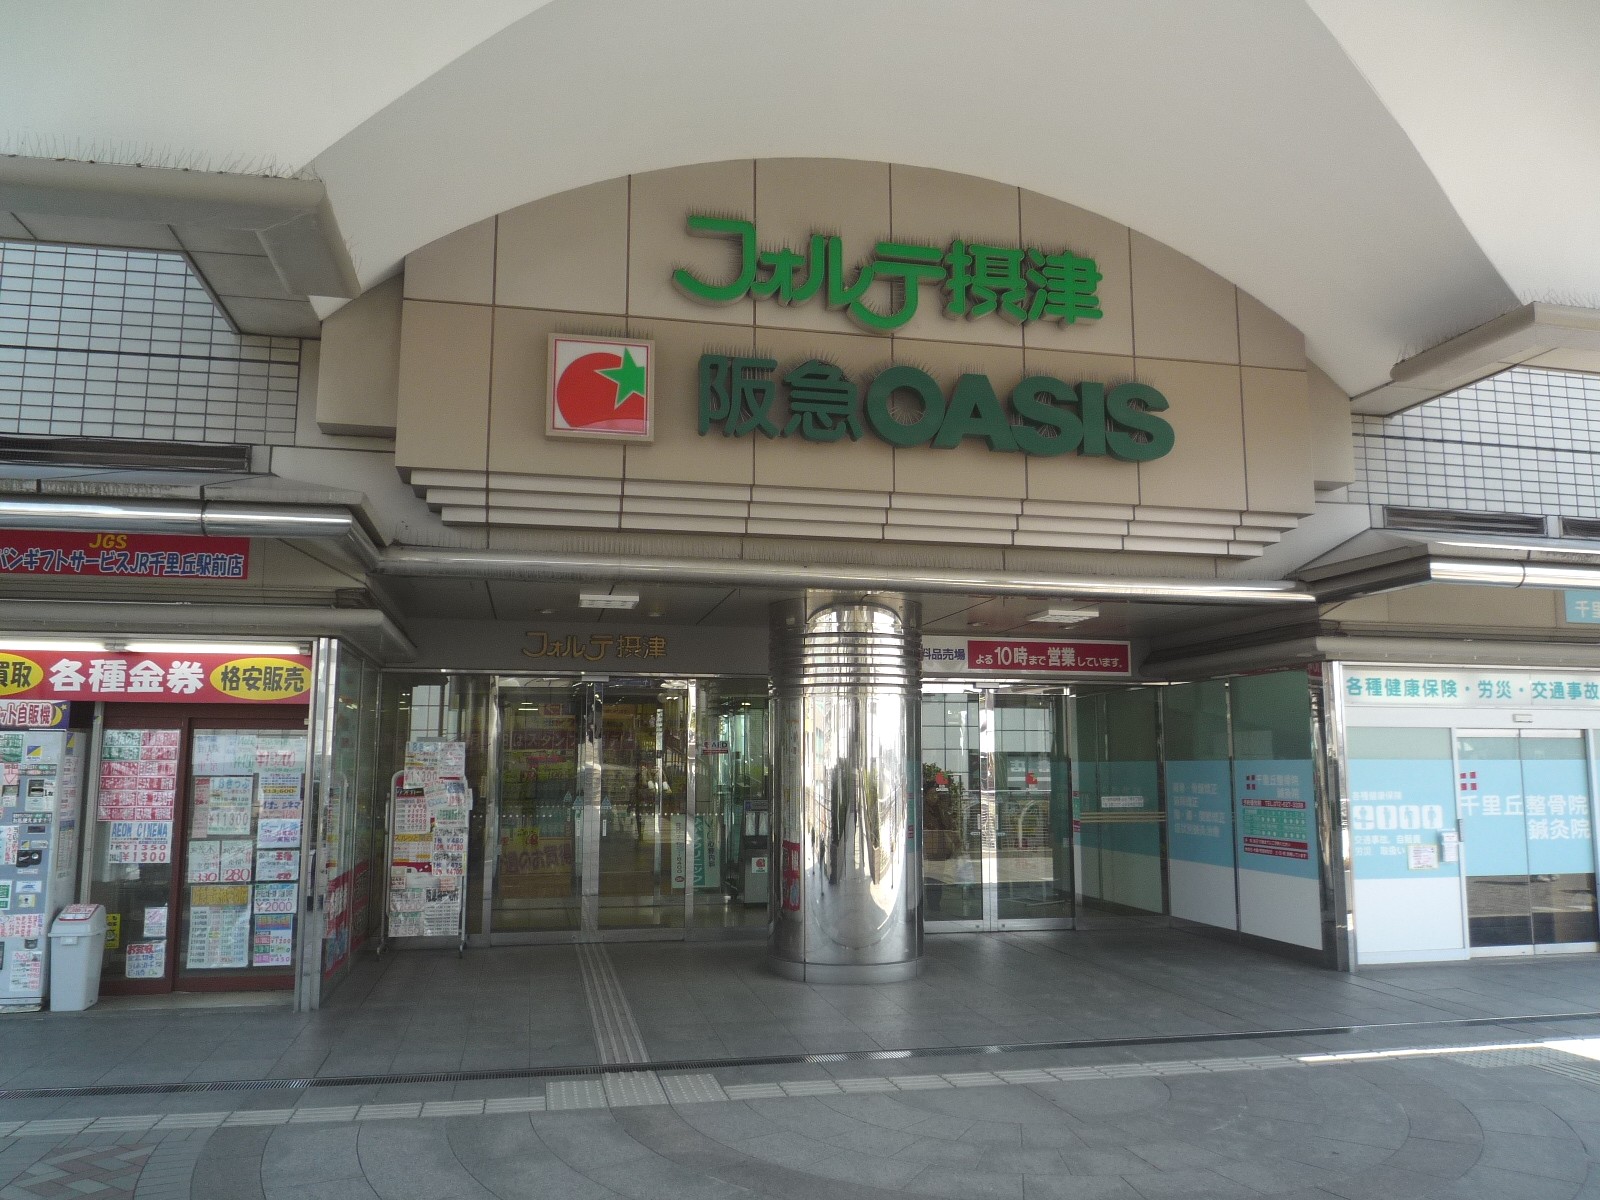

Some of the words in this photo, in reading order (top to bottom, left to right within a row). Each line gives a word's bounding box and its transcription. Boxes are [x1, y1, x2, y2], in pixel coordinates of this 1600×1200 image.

[672, 214, 1104, 333] フォルテ摂津
[89, 534, 128, 550] JGS
[521, 631, 668, 661] フォルテ摂津
[49, 658, 204, 694] 各種金券
[221, 665, 304, 693] 格安販売
[1460, 794, 1588, 816] 千里丘整骨院
[111, 822, 132, 837] AEON
[137, 822, 168, 837] CINEMA
[1529, 818, 1591, 840] 鍼灸院
